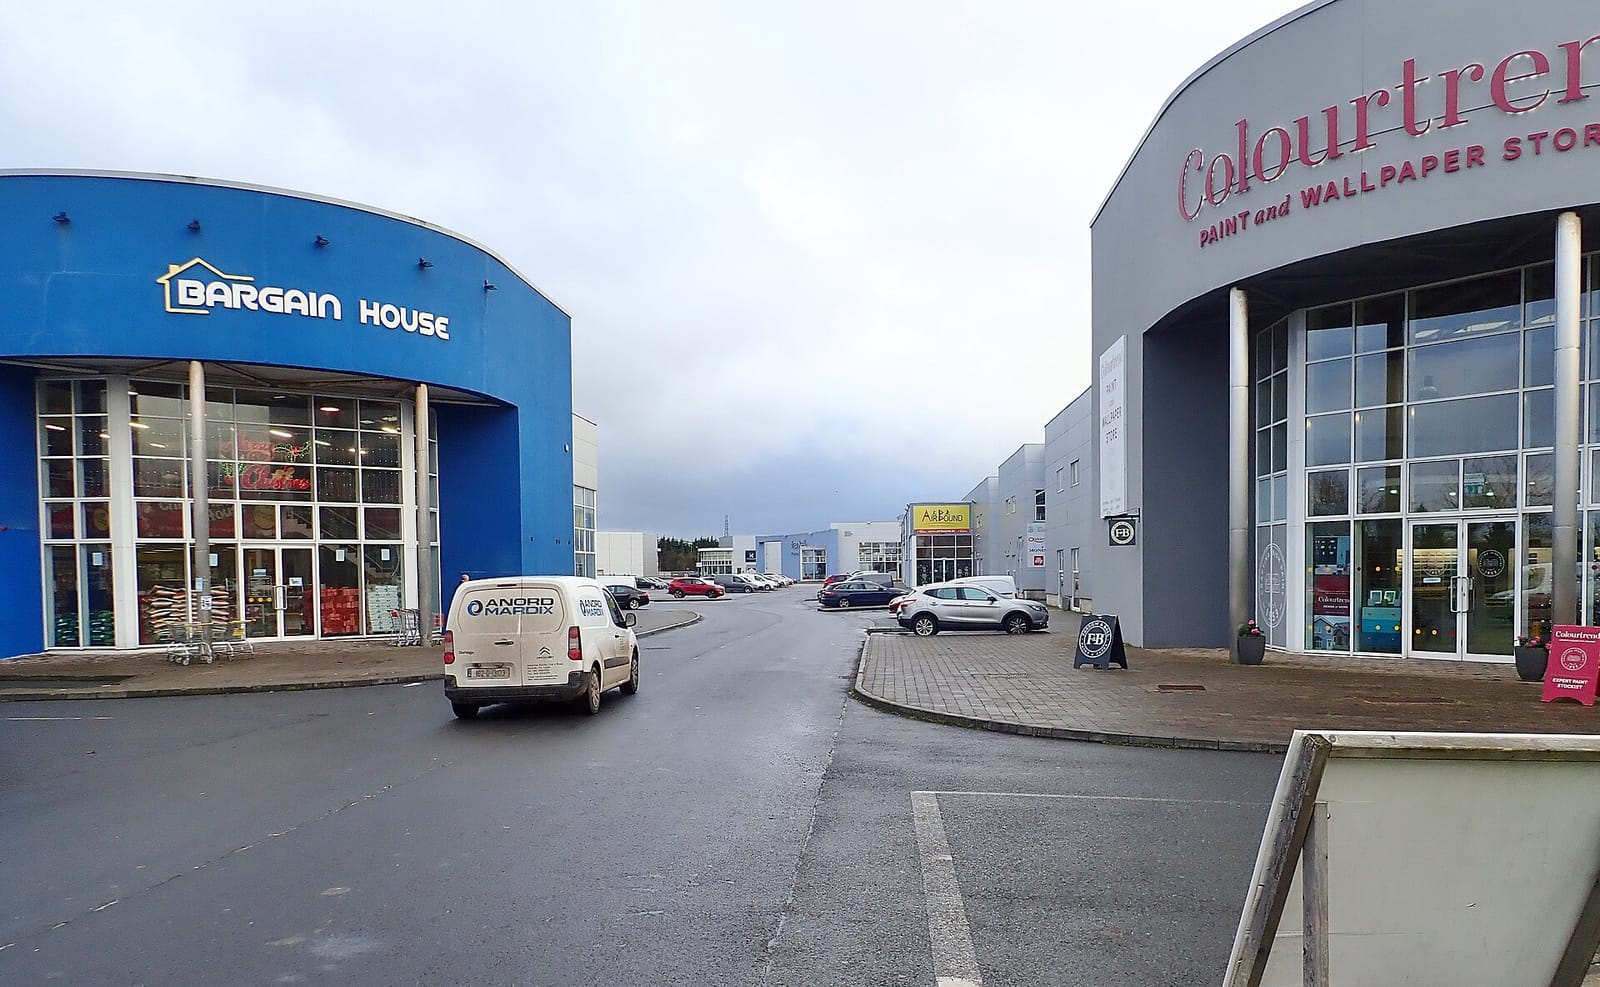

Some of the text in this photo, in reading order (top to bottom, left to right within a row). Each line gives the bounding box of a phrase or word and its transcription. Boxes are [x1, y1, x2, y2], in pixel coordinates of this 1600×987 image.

[1200, 211, 1250, 247] PAINT
[1253, 194, 1291, 225] and
[1300, 145, 1485, 208] WALLPAPER
[177, 279, 450, 340] BARGAIN HOUSE
[484, 606, 553, 616] MARDIX
[486, 598, 554, 606] ANORD
